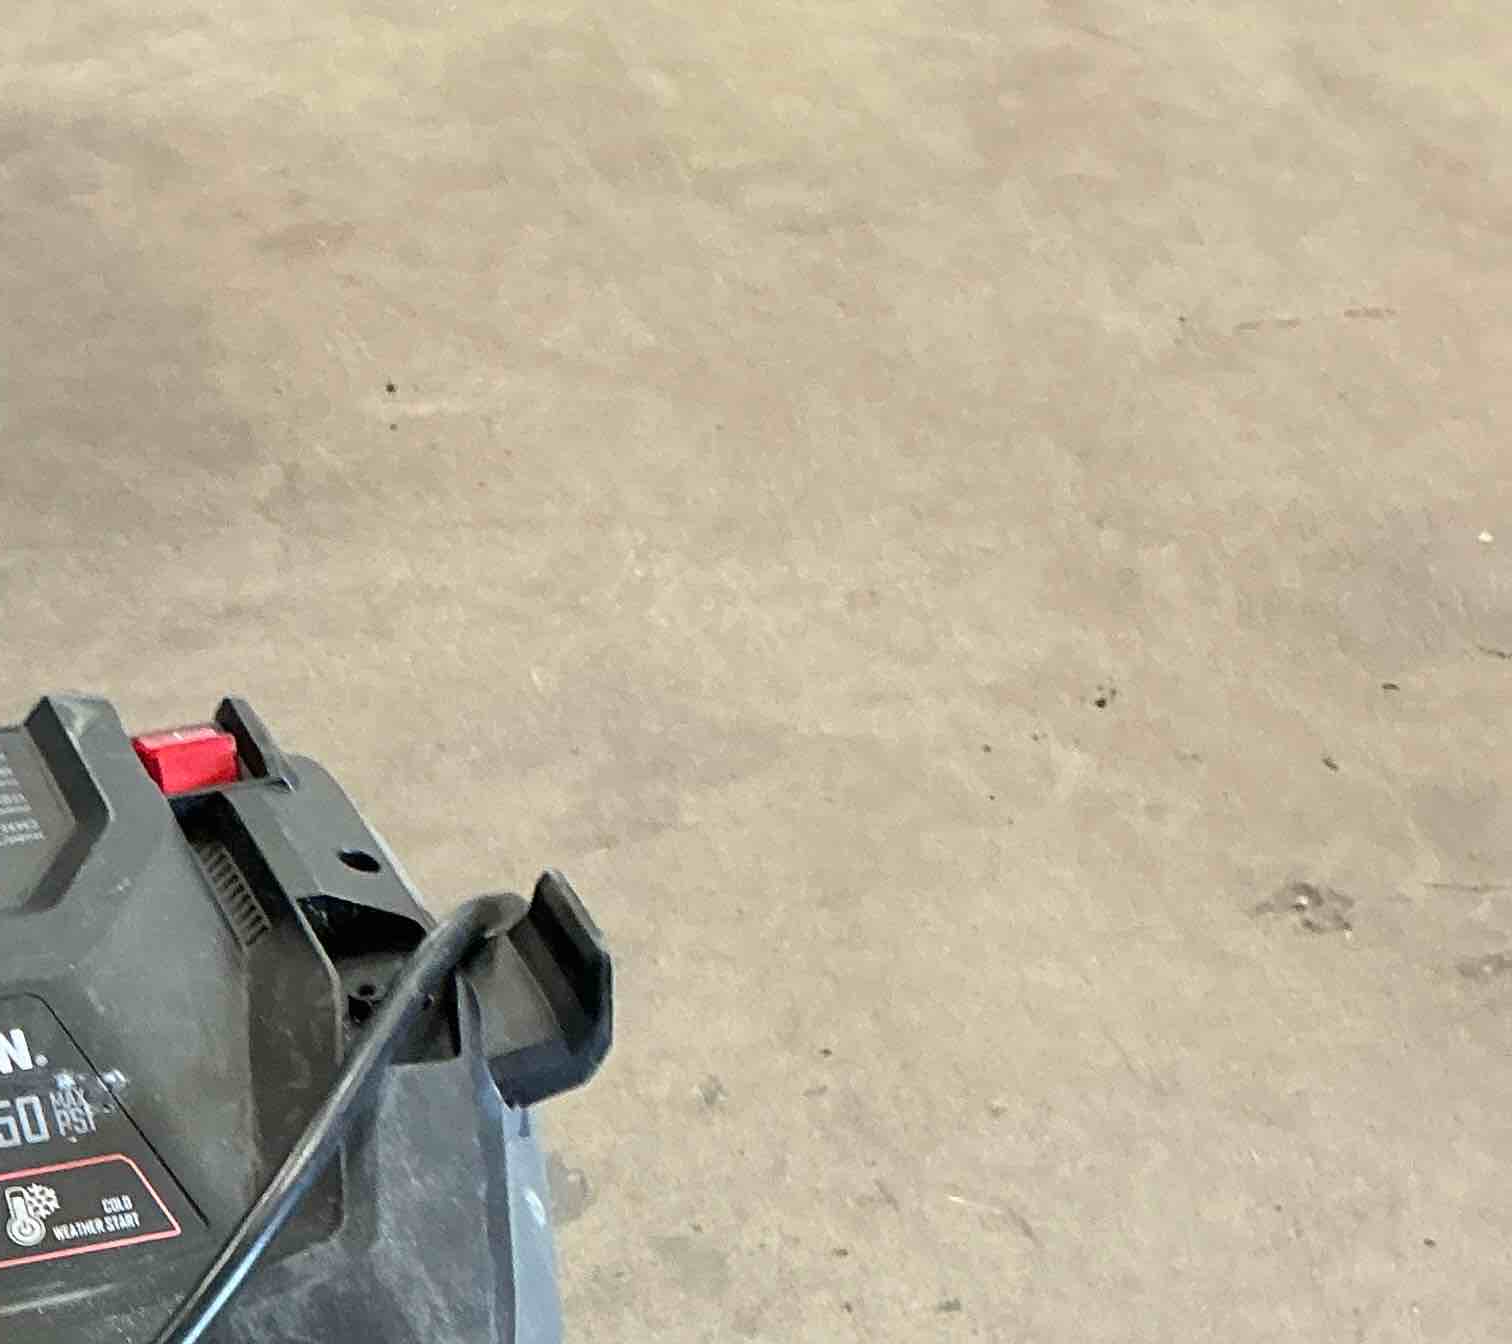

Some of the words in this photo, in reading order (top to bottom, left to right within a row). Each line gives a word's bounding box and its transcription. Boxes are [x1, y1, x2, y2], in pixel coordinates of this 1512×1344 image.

[54, 1103, 97, 1137] PSI
[101, 1194, 132, 1214] COLD
[52, 1215, 105, 1242] WEATHER
[104, 1211, 142, 1234] START
